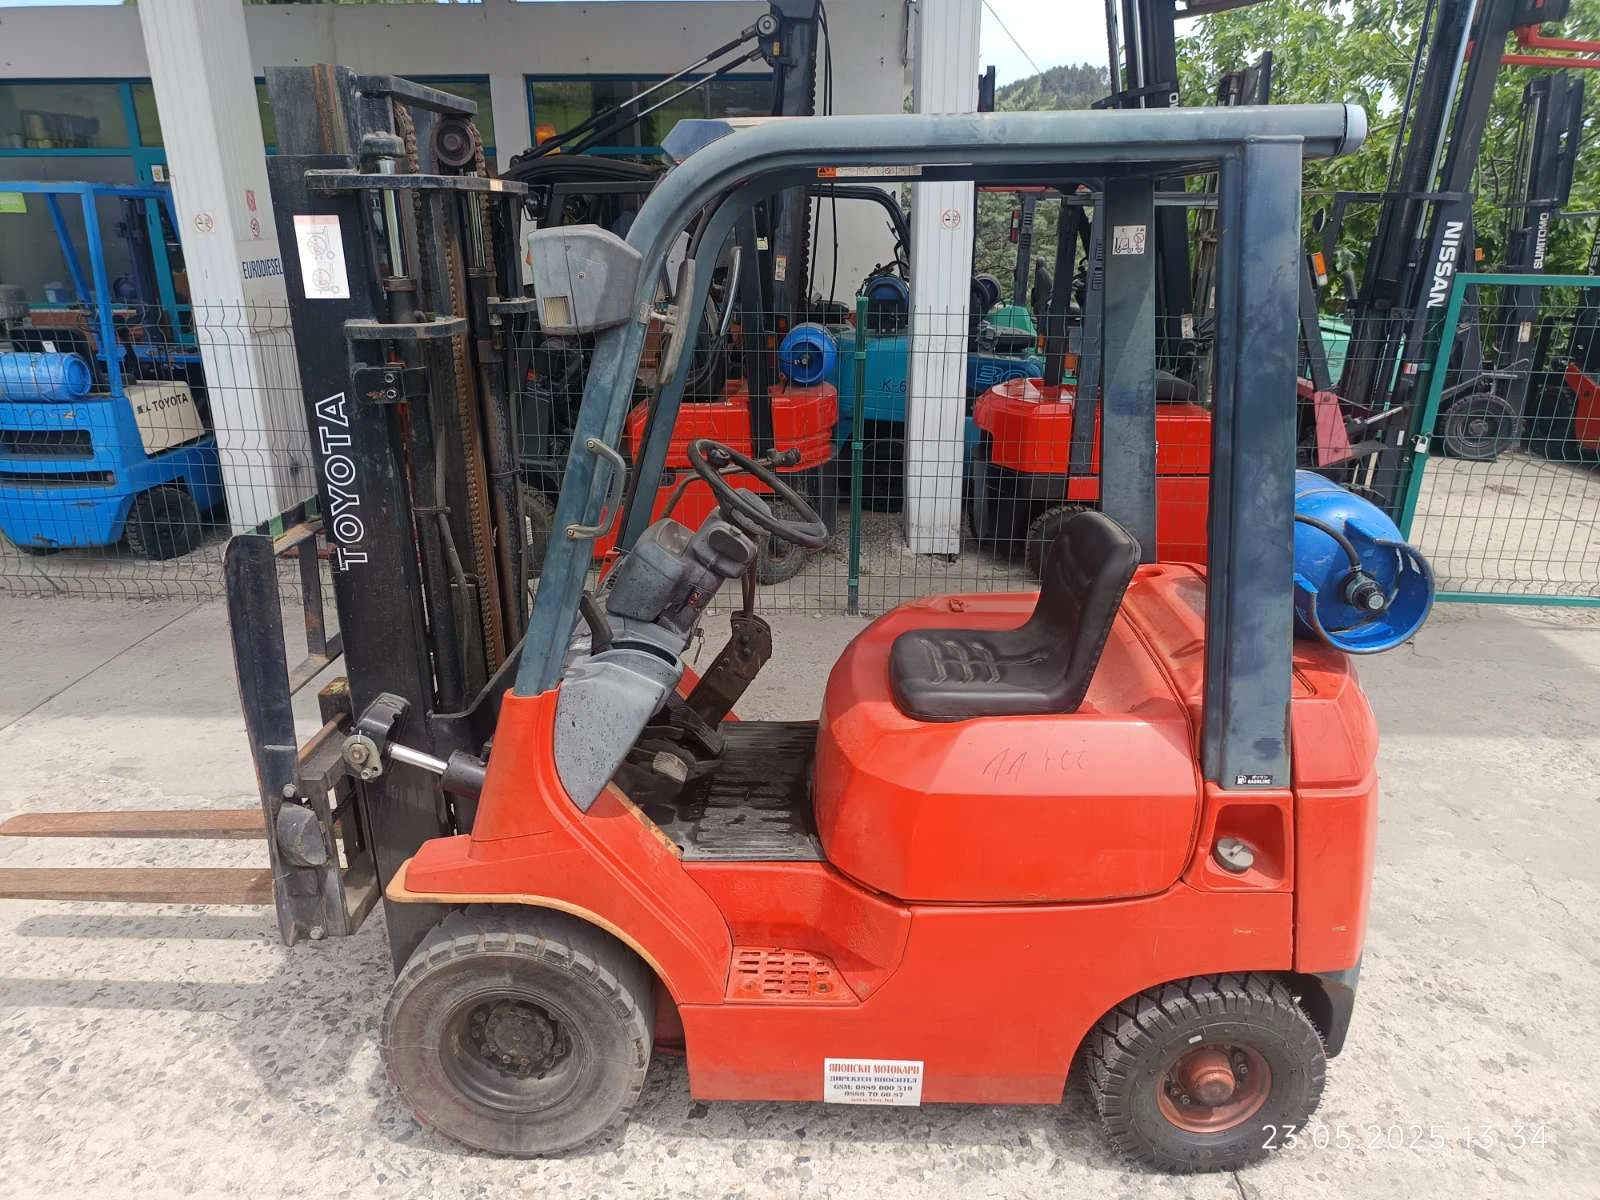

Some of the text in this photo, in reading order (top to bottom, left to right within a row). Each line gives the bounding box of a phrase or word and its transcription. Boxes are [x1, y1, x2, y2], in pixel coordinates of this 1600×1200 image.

[1533, 212, 1550, 270] SUMITOMO
[242, 258, 284, 279] EURODIESEL
[1426, 221, 1464, 309] NISSAN
[152, 392, 189, 412] TOYOTA
[314, 391, 369, 571] TOYOTA
[873, 1064, 920, 1075] МОТОКАРИ
